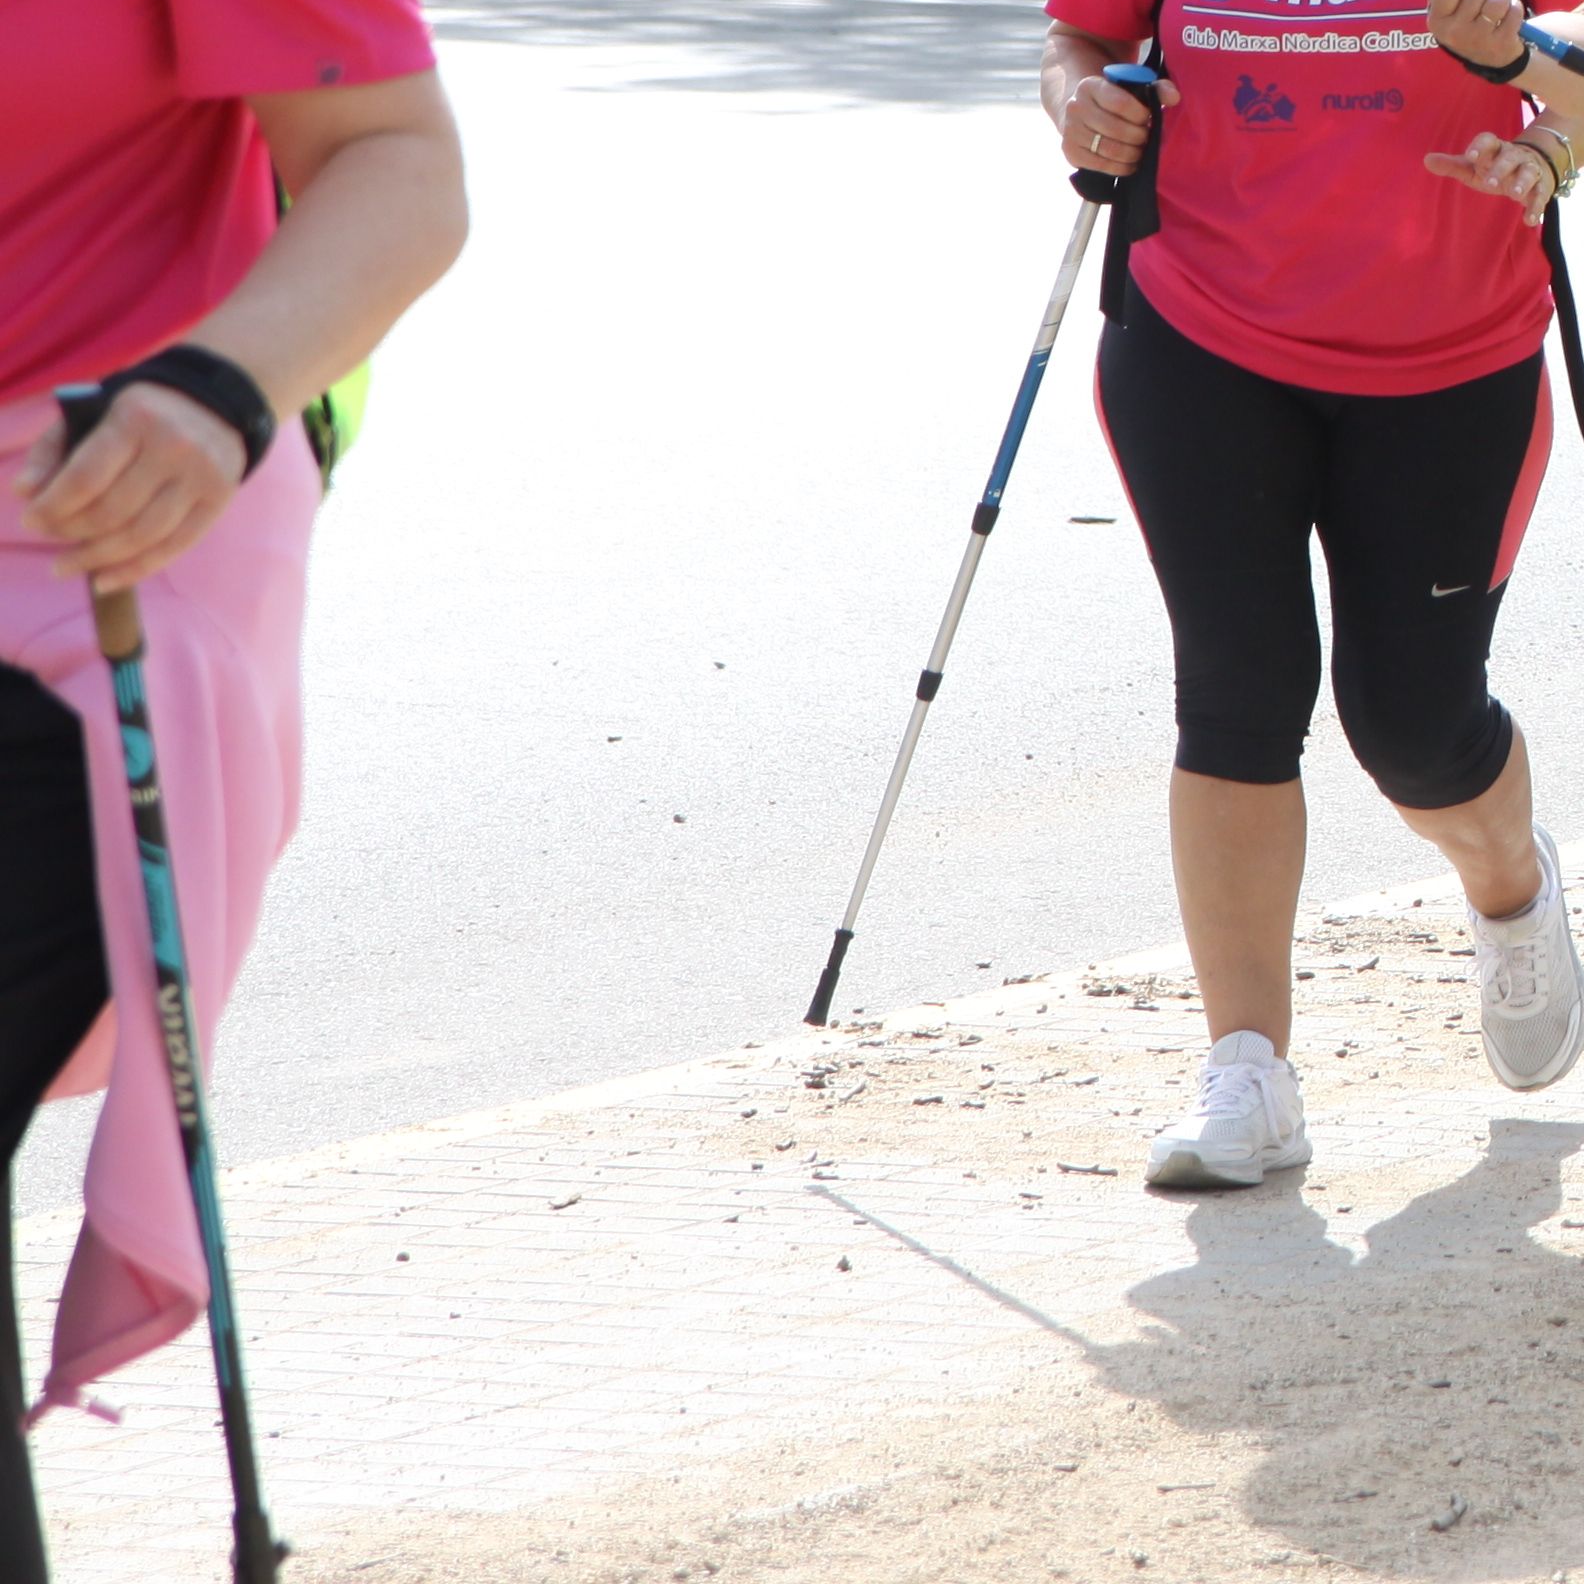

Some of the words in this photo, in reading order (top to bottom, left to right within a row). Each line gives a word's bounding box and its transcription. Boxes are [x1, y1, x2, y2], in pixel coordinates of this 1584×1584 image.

[1183, 26, 1217, 49] Club
[1221, 30, 1280, 52] Marxa
[1284, 31, 1359, 53] Nòrdica
[1321, 91, 1385, 112] nuroil
